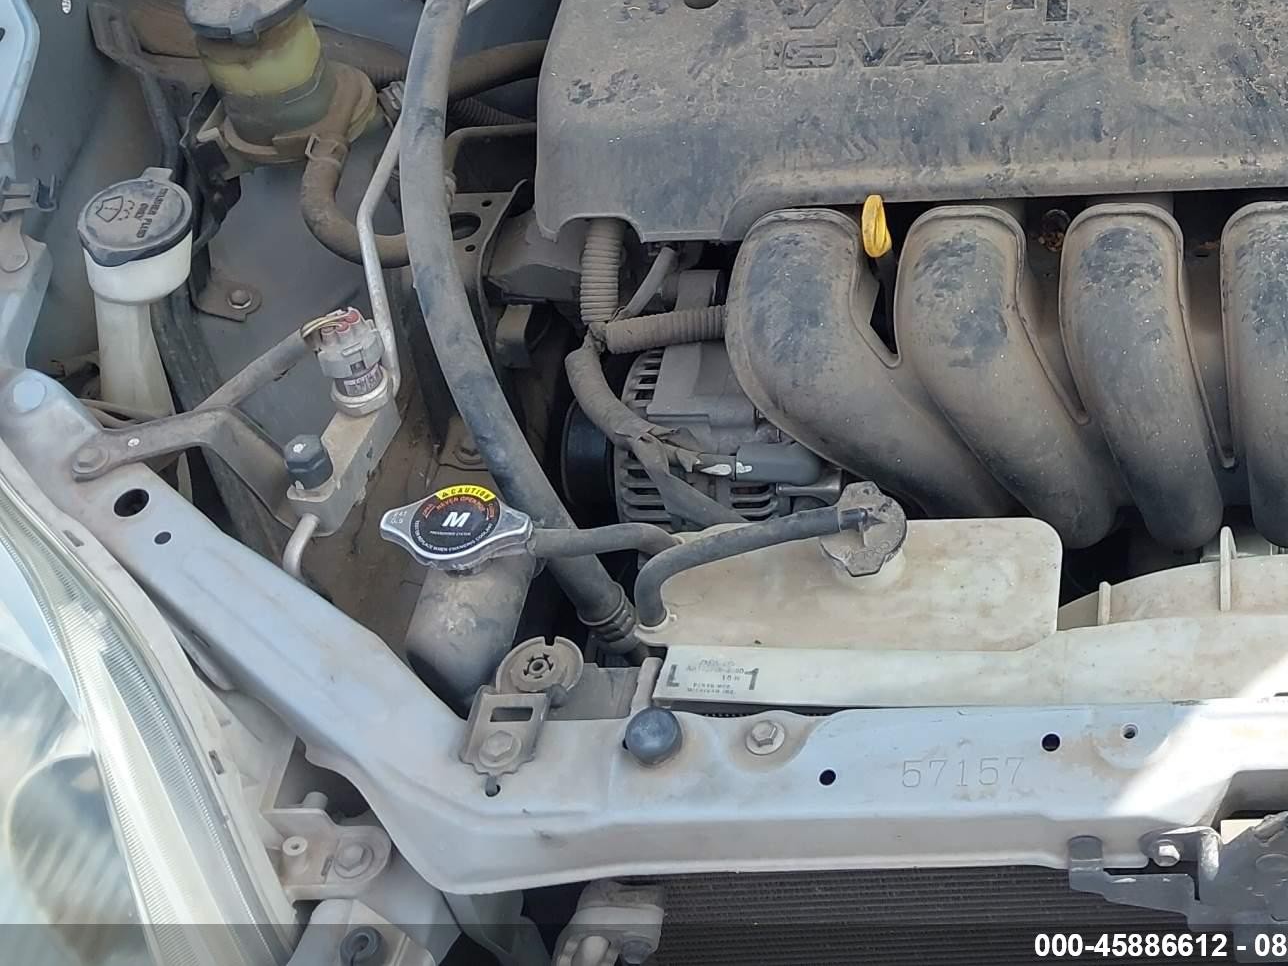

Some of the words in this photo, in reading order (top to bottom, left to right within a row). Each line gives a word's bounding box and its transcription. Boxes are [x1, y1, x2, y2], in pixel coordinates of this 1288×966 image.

[450, 486, 492, 500] CAUTION
[442, 511, 471, 528] M
[902, 756, 1024, 788] 57157
